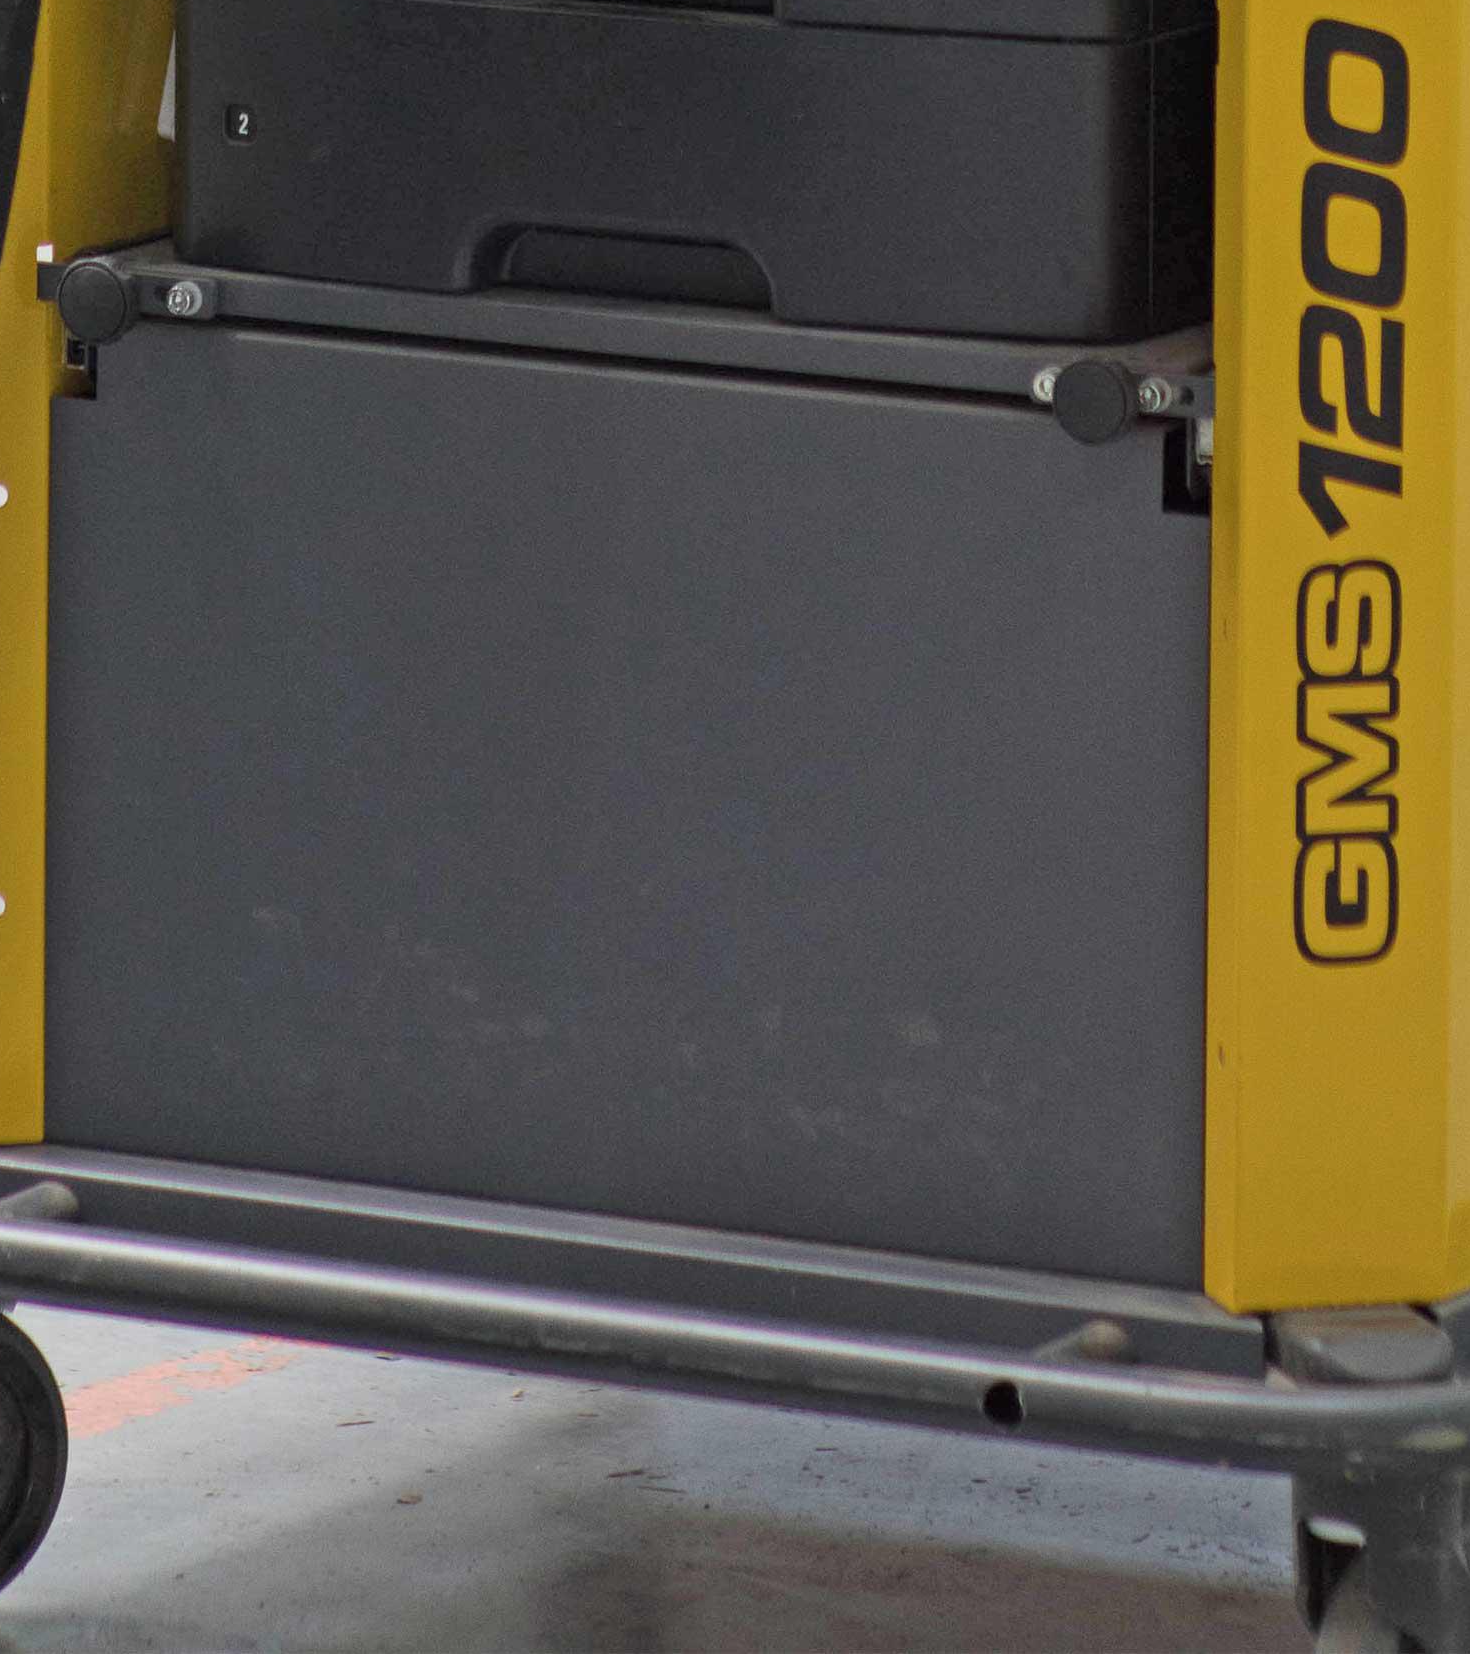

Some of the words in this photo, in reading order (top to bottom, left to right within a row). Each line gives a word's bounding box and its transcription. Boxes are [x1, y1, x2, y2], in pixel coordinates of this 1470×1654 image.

[238, 113, 249, 135] 2
[1297, 18, 1410, 541] 1200
[1294, 557, 1403, 967] GMS
